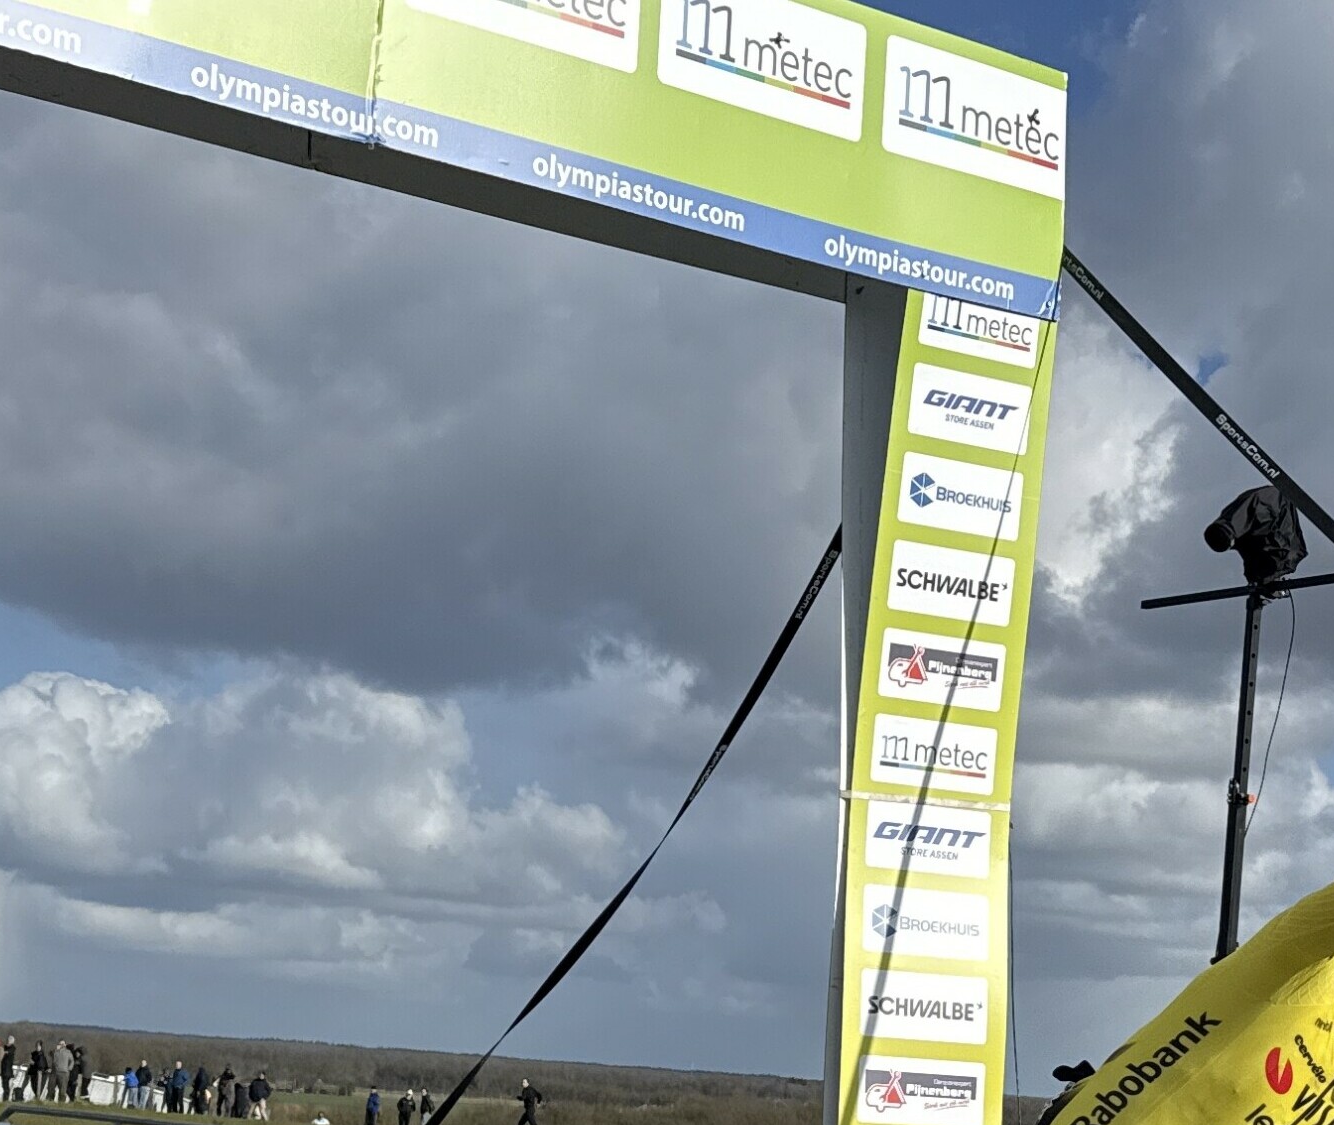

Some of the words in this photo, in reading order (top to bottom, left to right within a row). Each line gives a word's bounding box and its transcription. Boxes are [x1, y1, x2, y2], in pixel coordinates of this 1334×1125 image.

[743, 36, 853, 100] metec
[190, 62, 440, 149] olympiastour.com
[961, 103, 1059, 162] metec
[532, 153, 746, 232] olympiastour.com
[823, 234, 1014, 300] olympiastour.com
[1061, 252, 1104, 300] rtsCom.nl
[966, 312, 1033, 346] metec
[923, 389, 1019, 420] GIANT
[945, 413, 969, 426] STORE
[969, 418, 994, 431] ASSEN
[1215, 413, 1280, 479] SportsCom.nl
[935, 486, 1012, 513] BROEKHUIS
[896, 568, 1000, 602] SCHWALBE
[914, 742, 988, 771] metec
[873, 821, 987, 848] GIANT
[900, 846, 928, 858] STORE
[929, 851, 959, 861] ASSEN
[899, 915, 980, 937] BROEKHUIS
[867, 995, 974, 1022] SCHWALBE
[1294, 1034, 1327, 1084] cervélo
